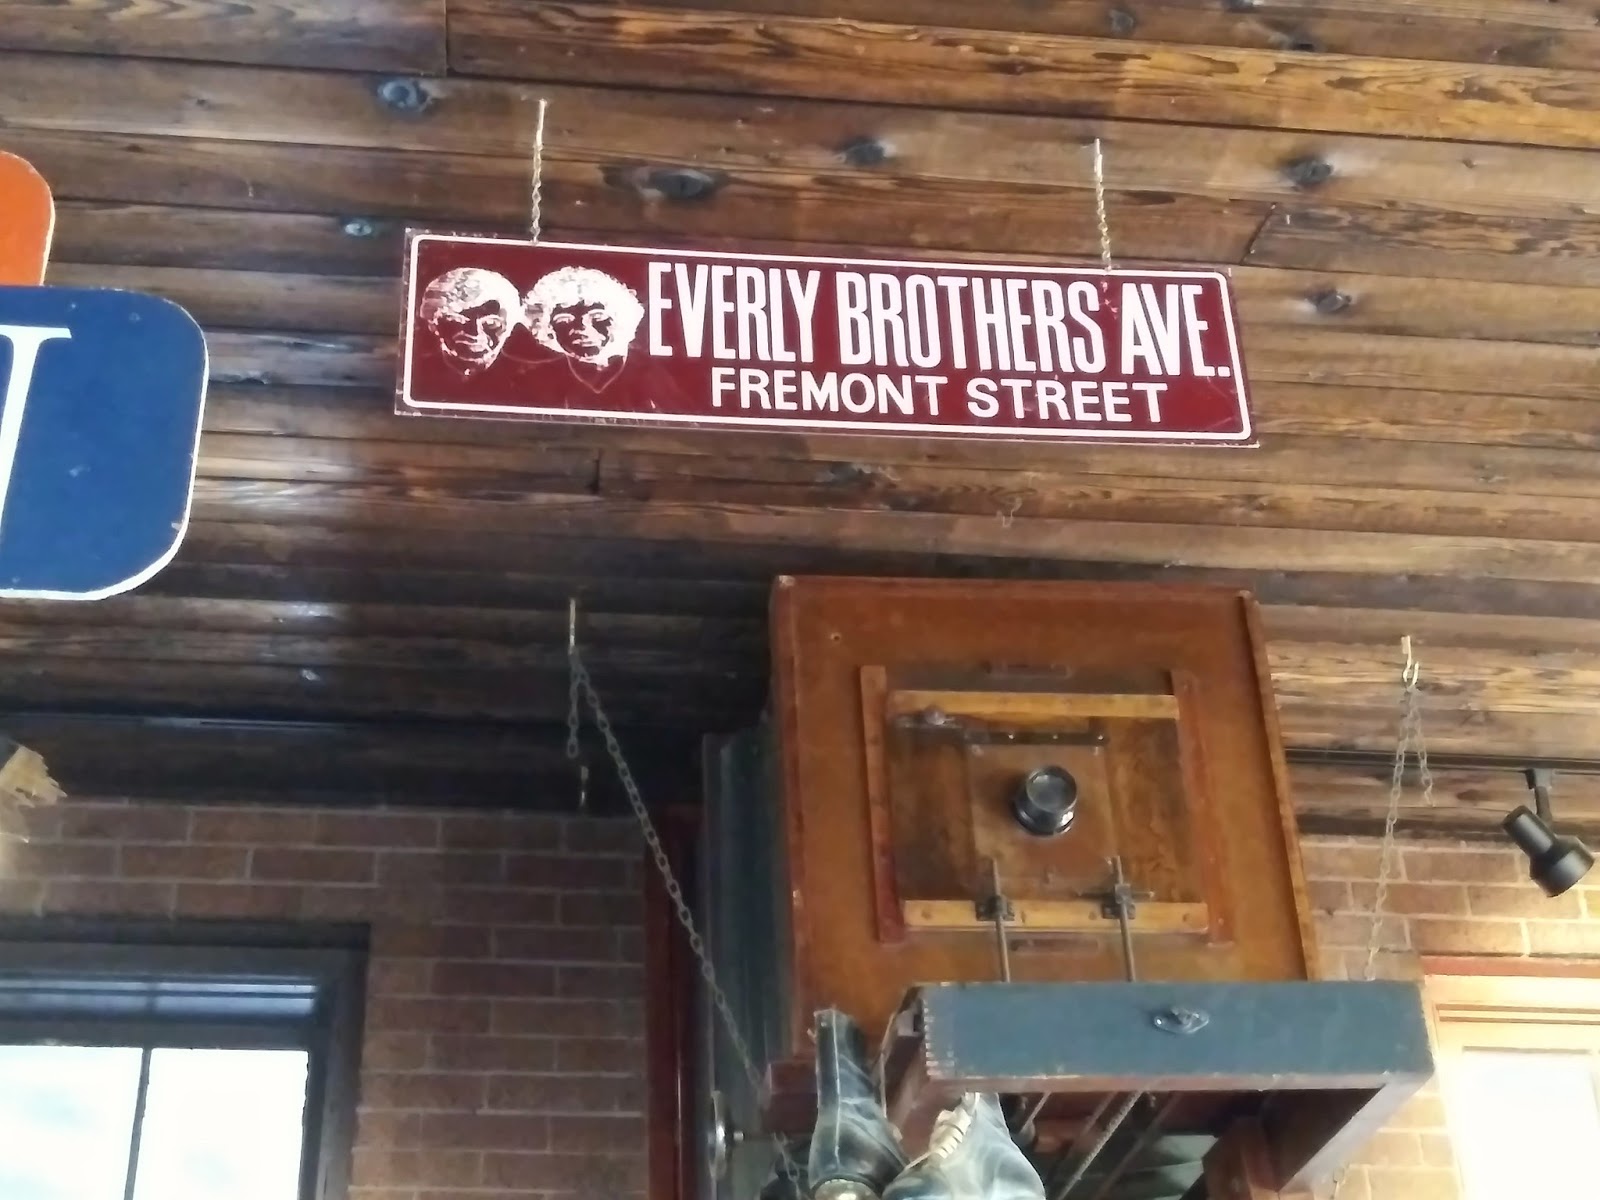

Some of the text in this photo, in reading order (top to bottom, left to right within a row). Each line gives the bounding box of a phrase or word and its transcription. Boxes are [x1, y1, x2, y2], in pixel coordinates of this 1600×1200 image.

[648, 261, 1231, 379] EVERLY BROTHERS AVE.
[711, 366, 1168, 424] FREMONT STREET
